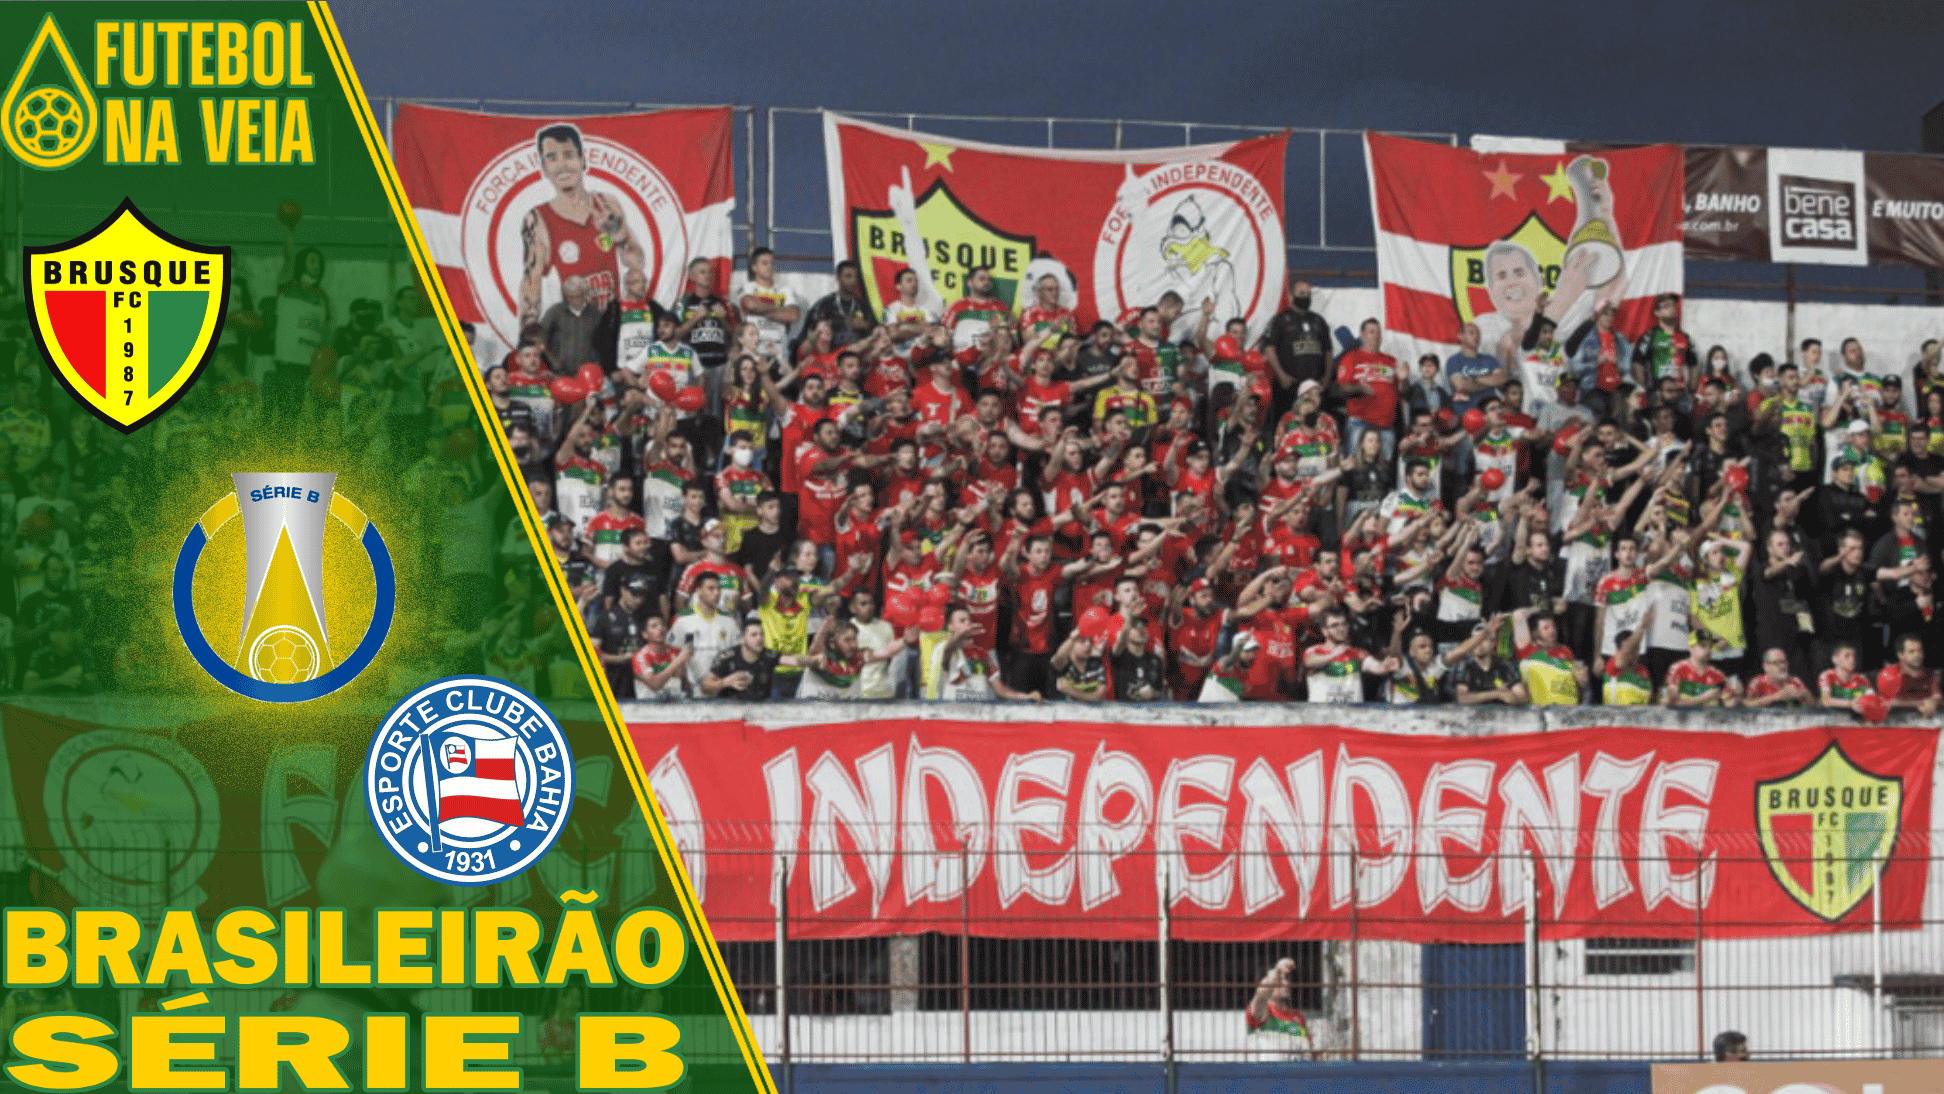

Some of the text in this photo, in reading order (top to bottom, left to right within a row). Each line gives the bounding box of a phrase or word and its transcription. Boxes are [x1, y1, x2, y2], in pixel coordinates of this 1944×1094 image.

[1150, 163, 1274, 222] INDEPENDENTE
[1694, 192, 1762, 214] BANHO
[1784, 186, 1851, 216] bene
[1872, 200, 1944, 220] E MUITO
[1785, 217, 1853, 241] casa
[869, 224, 1019, 273] BRSQUE
[1768, 785, 1889, 810] BRUSQUE
[763, 732, 1719, 918] INDEPENDENTE
[1817, 811, 1840, 828] FC
